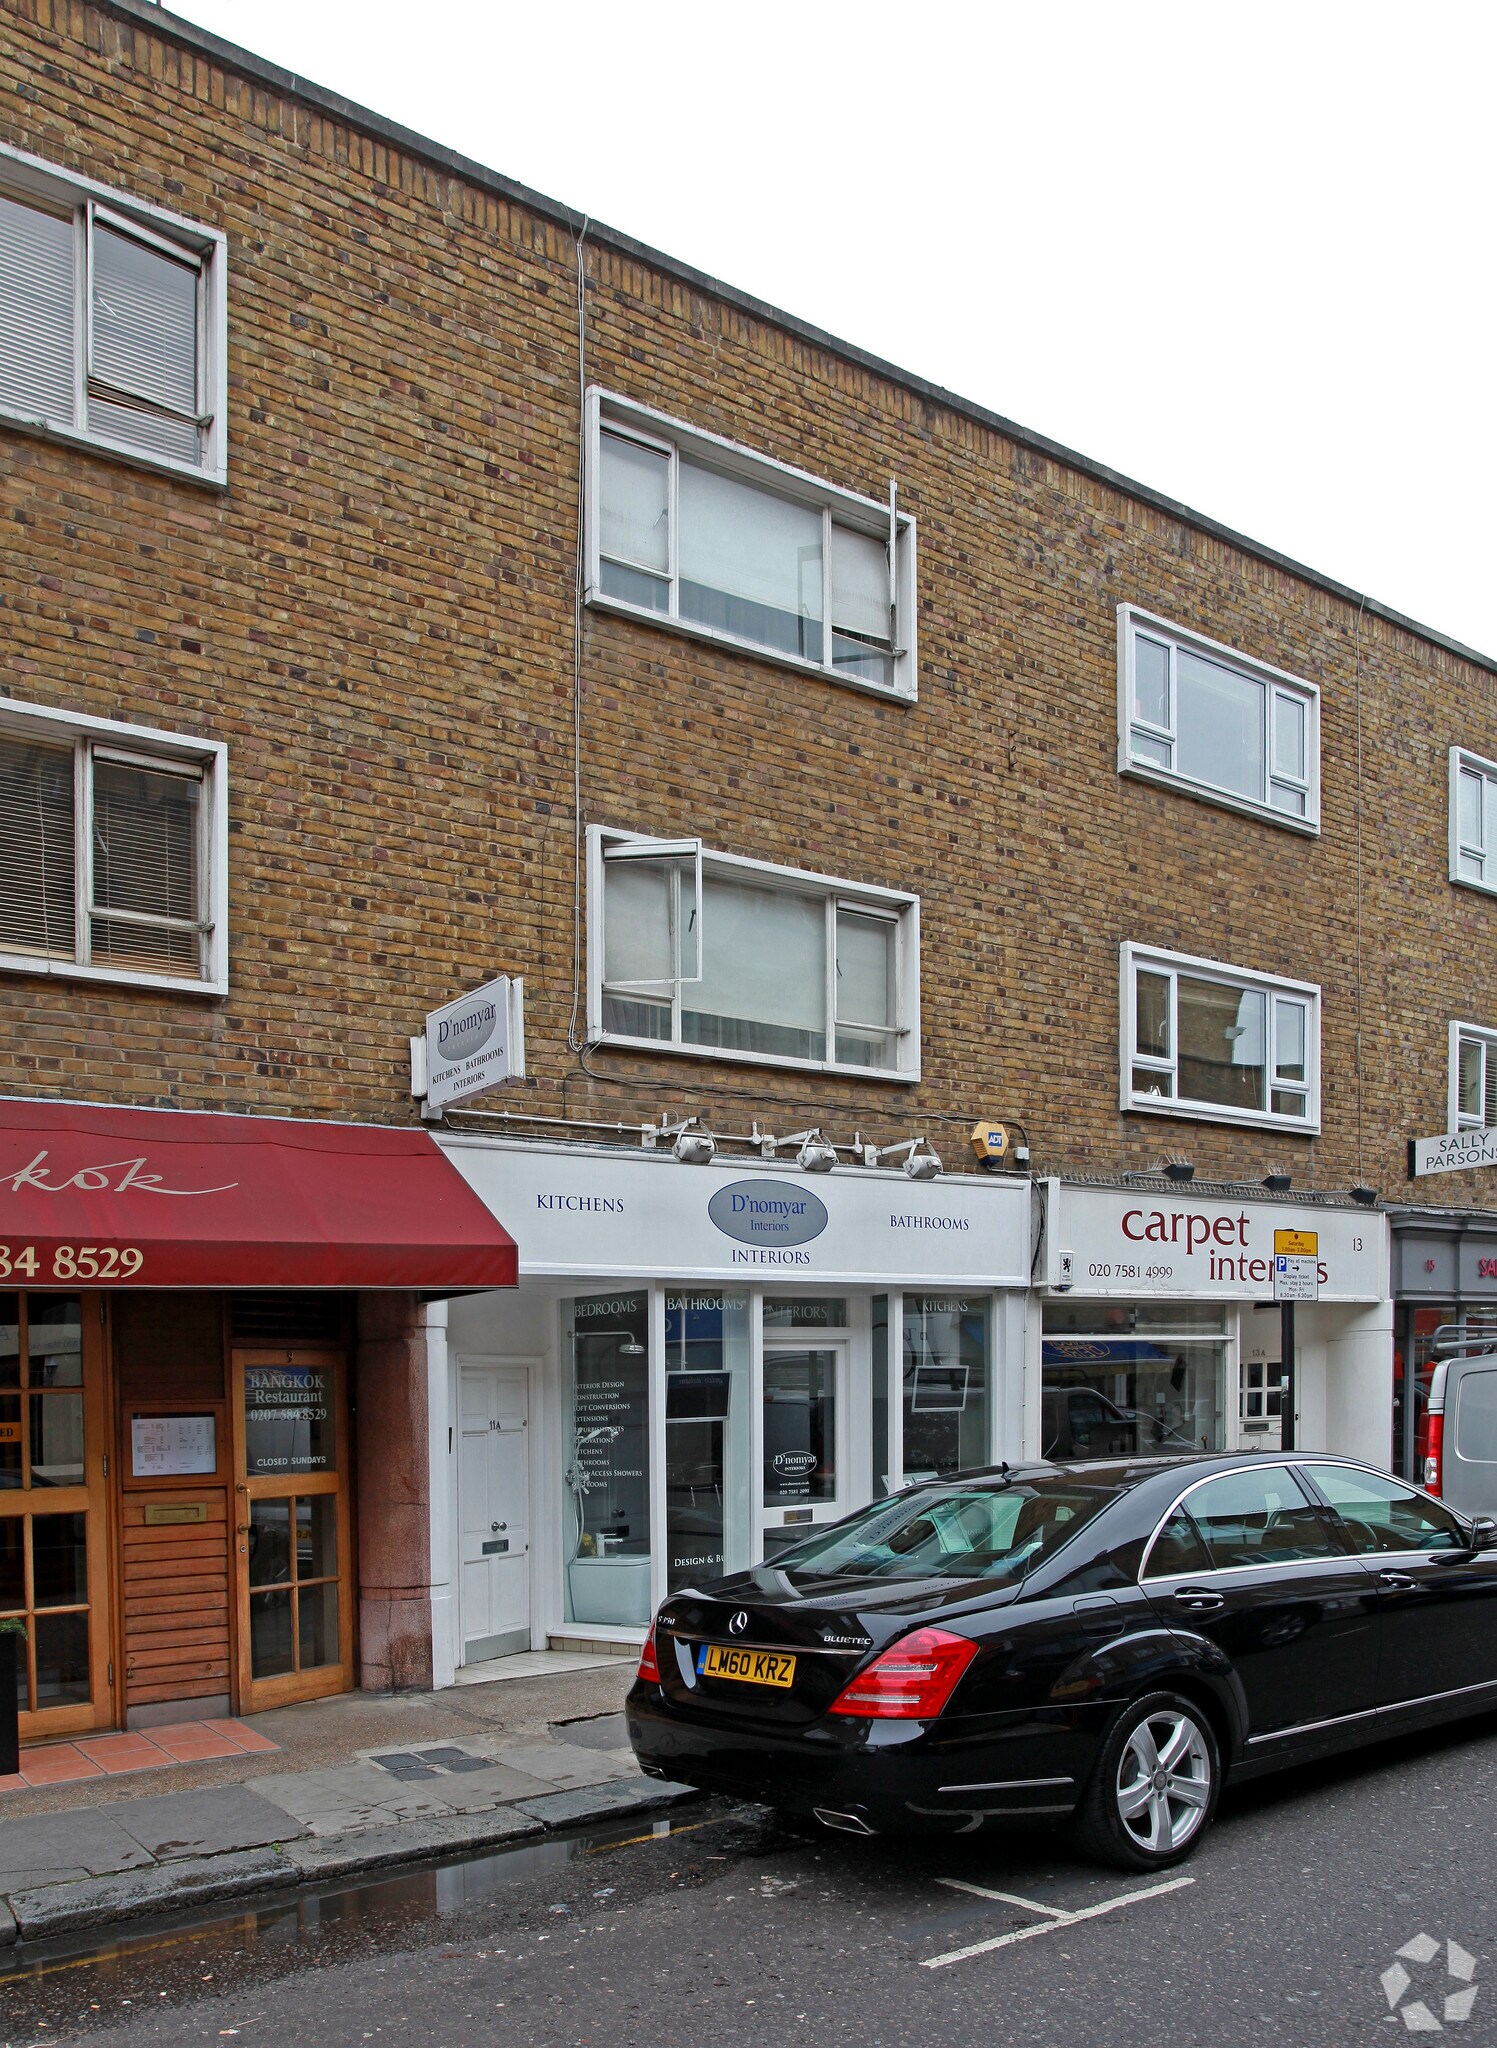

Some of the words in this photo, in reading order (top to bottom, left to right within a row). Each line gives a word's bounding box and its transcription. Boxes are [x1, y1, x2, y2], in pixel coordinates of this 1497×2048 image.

[438, 1003, 496, 1043] D'nomyar
[432, 1065, 461, 1085] KITCHENS
[465, 1046, 504, 1071] BATHROOMS
[452, 1070, 486, 1091] INTERIORS
[988, 1134, 1003, 1145] ADT
[1439, 1132, 1490, 1153] SALLY
[1426, 1147, 1497, 1169] PARSON
[536, 1194, 624, 1213] KITCHENS
[731, 1194, 807, 1218] D'nomyar
[750, 1219, 789, 1232] Interiors
[889, 1215, 969, 1230] BATHROOMS
[1121, 1209, 1250, 1255] carpet
[1352, 1237, 1363, 1252] 13
[53, 1245, 144, 1279] 8529
[732, 1249, 810, 1265] INTERIORS
[1278, 1257, 1286, 1271] P
[1088, 1263, 1111, 1277] 020
[1114, 1264, 1141, 1278] 7581
[1145, 1266, 1173, 1279] 4999
[1209, 1248, 1329, 1285] inters
[1427, 1258, 1436, 1272] 15
[574, 1299, 637, 1318] BEDROOMS
[667, 1297, 743, 1311] BATHROOMS
[922, 1300, 968, 1312] KITCHENS
[250, 1374, 325, 1389] BANGKOK
[575, 1382, 601, 1390] NTERIOR
[602, 1380, 624, 1388] DESIGN
[255, 1389, 323, 1404] Restaurant
[576, 1392, 619, 1400] ONSTRUCTION
[250, 1409, 277, 1421] 0207
[302, 1408, 327, 1421] 8529
[256, 1458, 288, 1467] CLOSED
[290, 1456, 327, 1465] SUNDAYS
[774, 1454, 817, 1466] D'nomyar
[613, 1469, 643, 1477] SHOWERS
[674, 1557, 705, 1567] DESIGN
[706, 1554, 714, 1564] &
[823, 1635, 872, 1645] BLUETEC
[707, 1649, 751, 1676] LM60
[754, 1655, 792, 1682] KRZ
